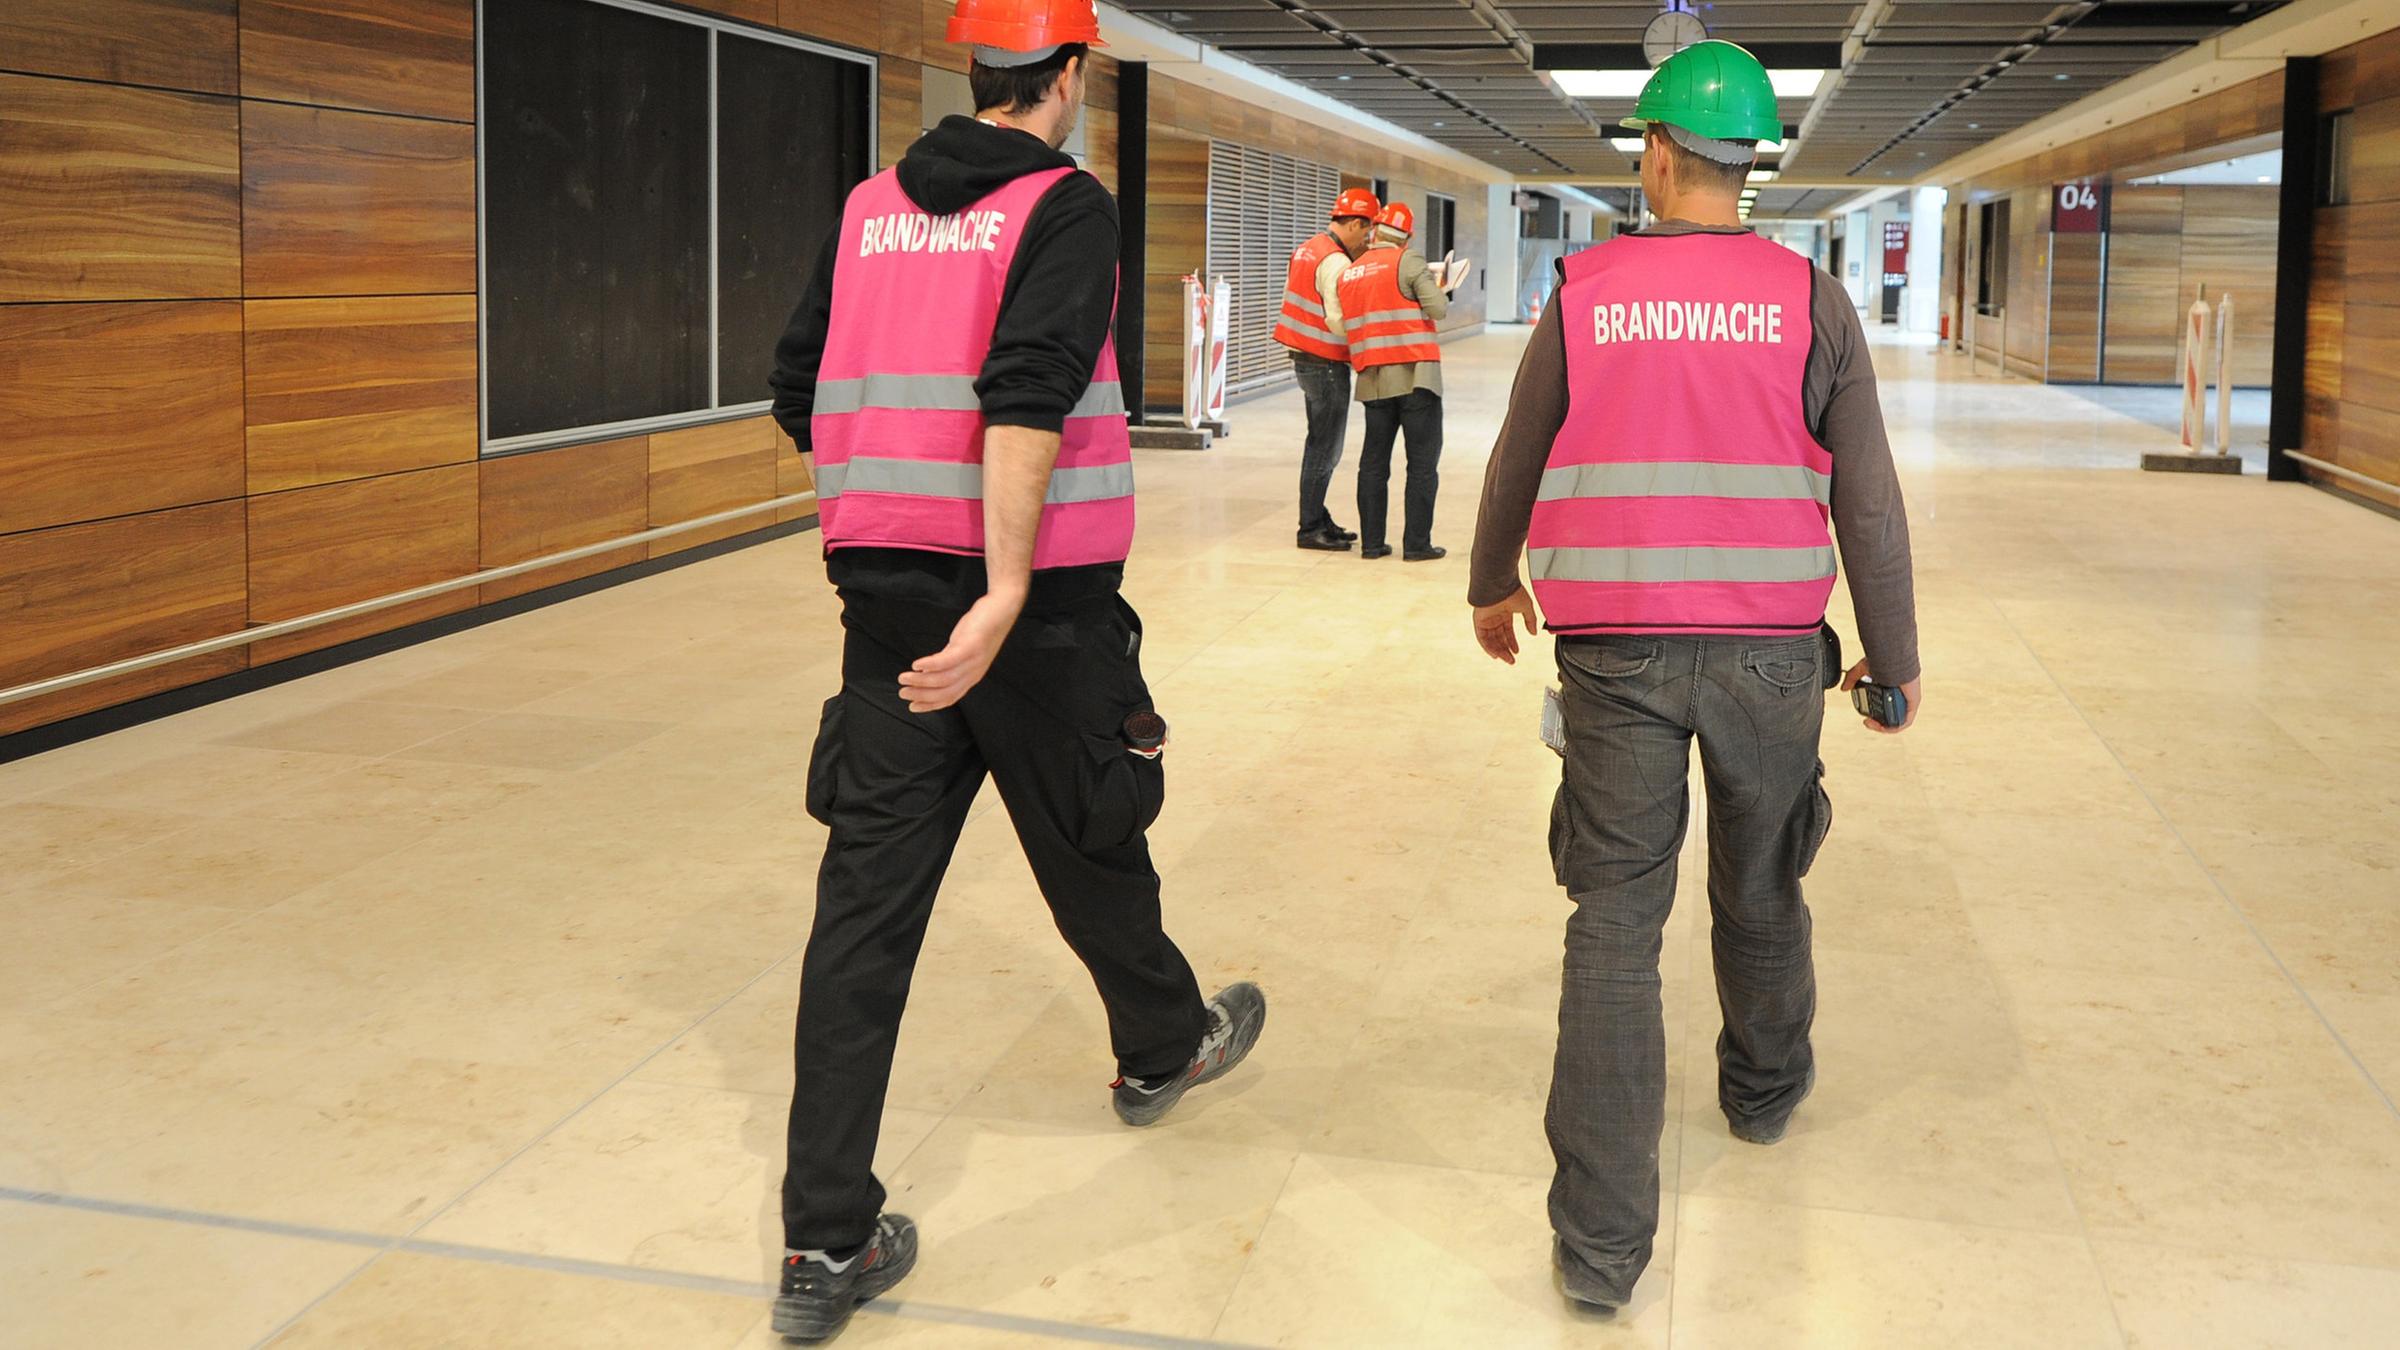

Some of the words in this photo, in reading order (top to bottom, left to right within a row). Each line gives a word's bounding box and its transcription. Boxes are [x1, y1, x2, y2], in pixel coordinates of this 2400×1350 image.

[2061, 185, 2097, 210] 04
[859, 210, 1006, 257] BRANDWACHE
[1594, 301, 1782, 345] BRANDWACHE
